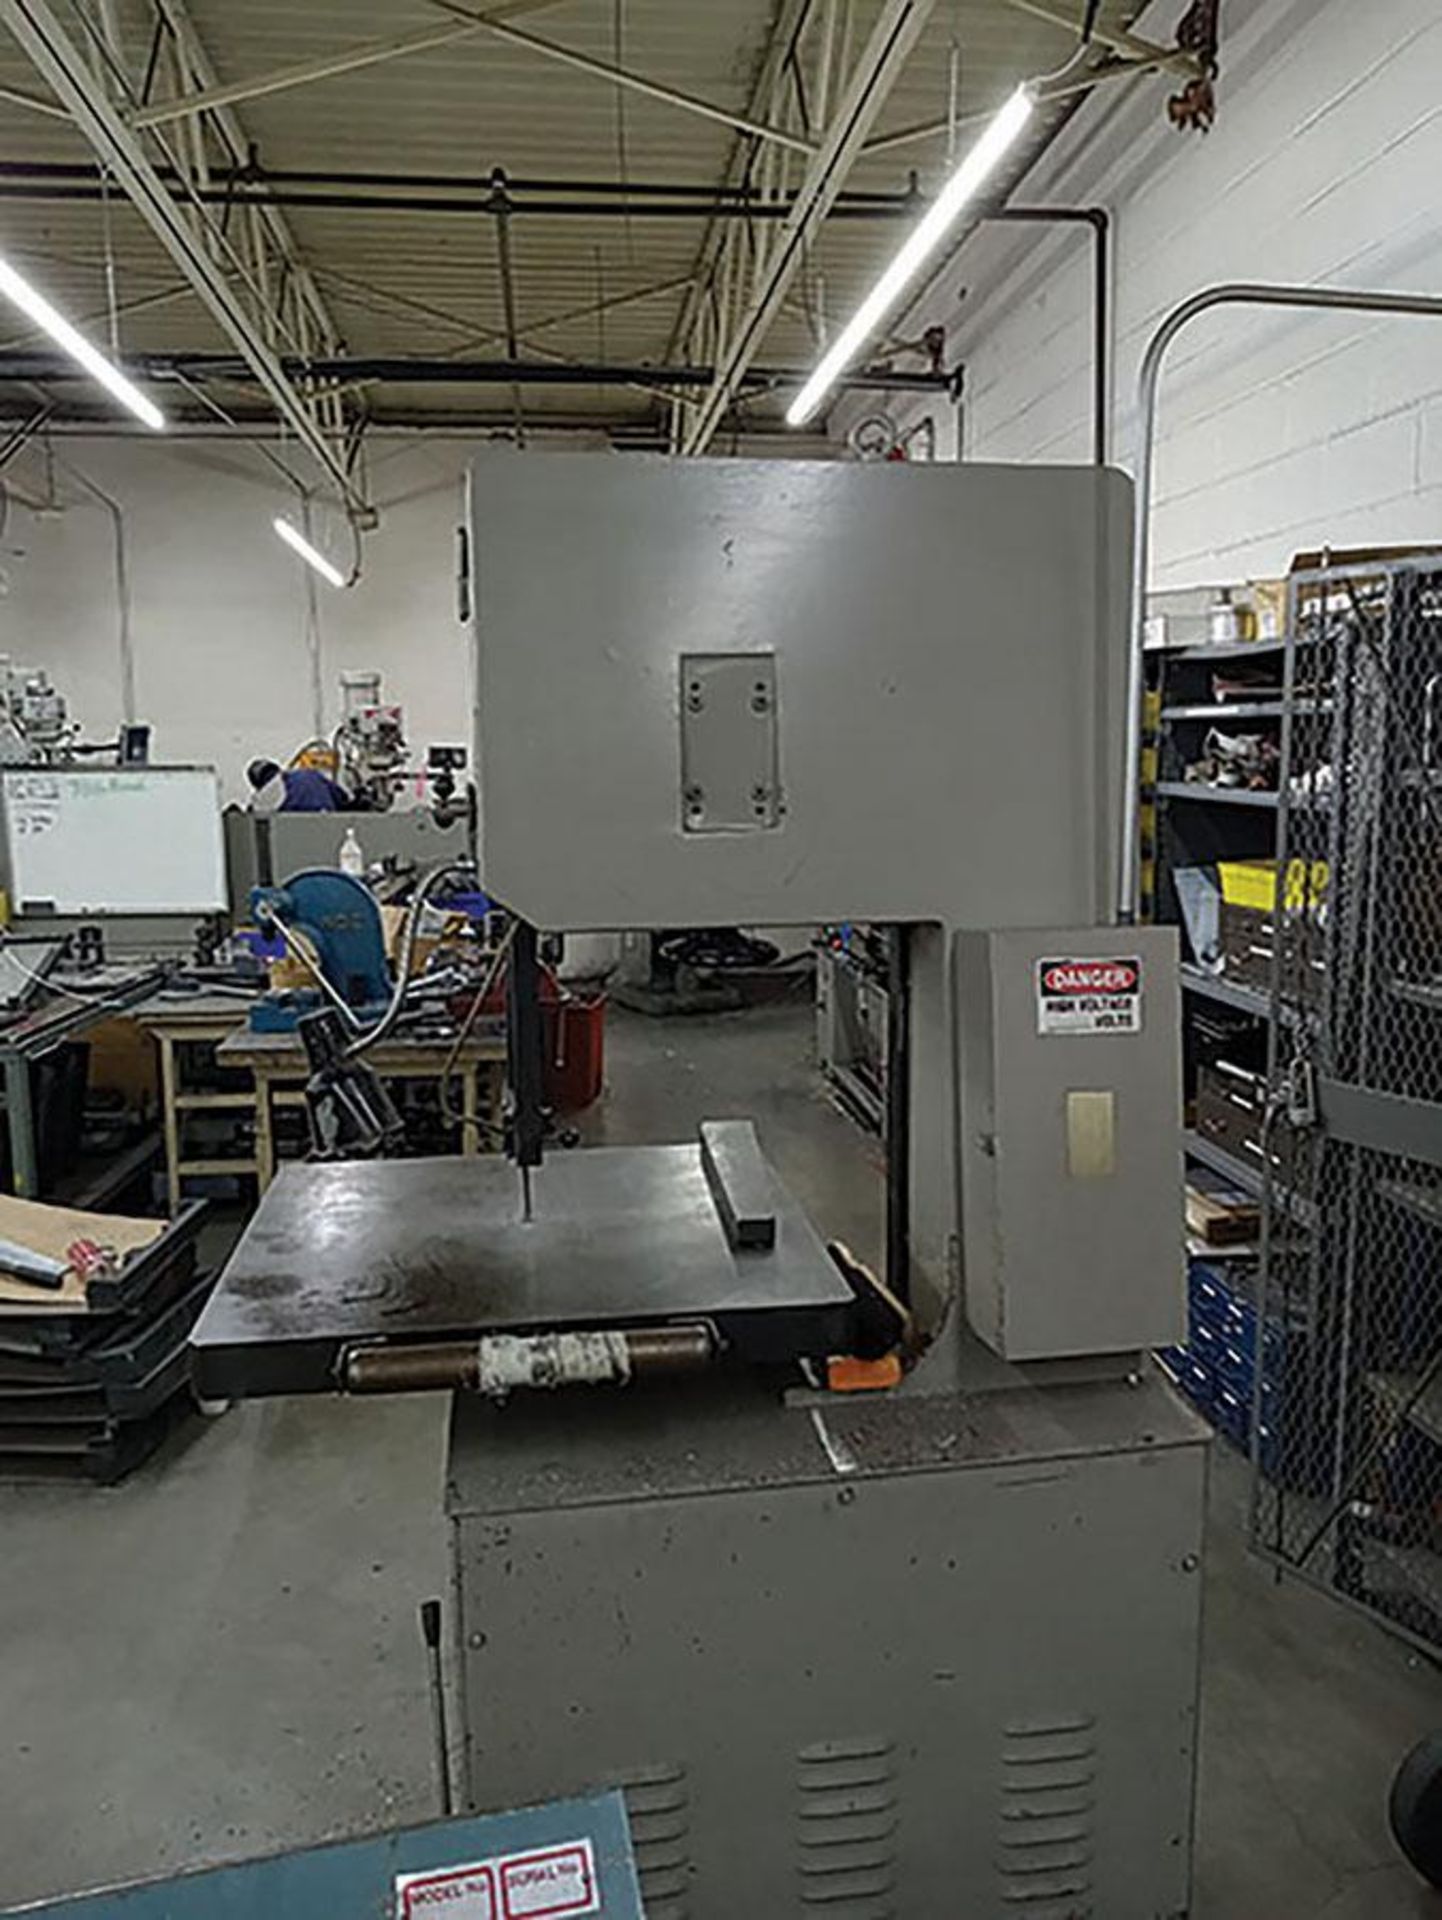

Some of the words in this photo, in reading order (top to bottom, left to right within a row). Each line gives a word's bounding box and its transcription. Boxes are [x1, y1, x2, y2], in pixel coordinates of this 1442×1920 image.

[1054, 968, 1129, 990] DANGER
[1080, 998, 1131, 1011] VOLTAGE
[1096, 1014, 1131, 1026] VOLTS
[411, 1887, 462, 1904] MODEL
